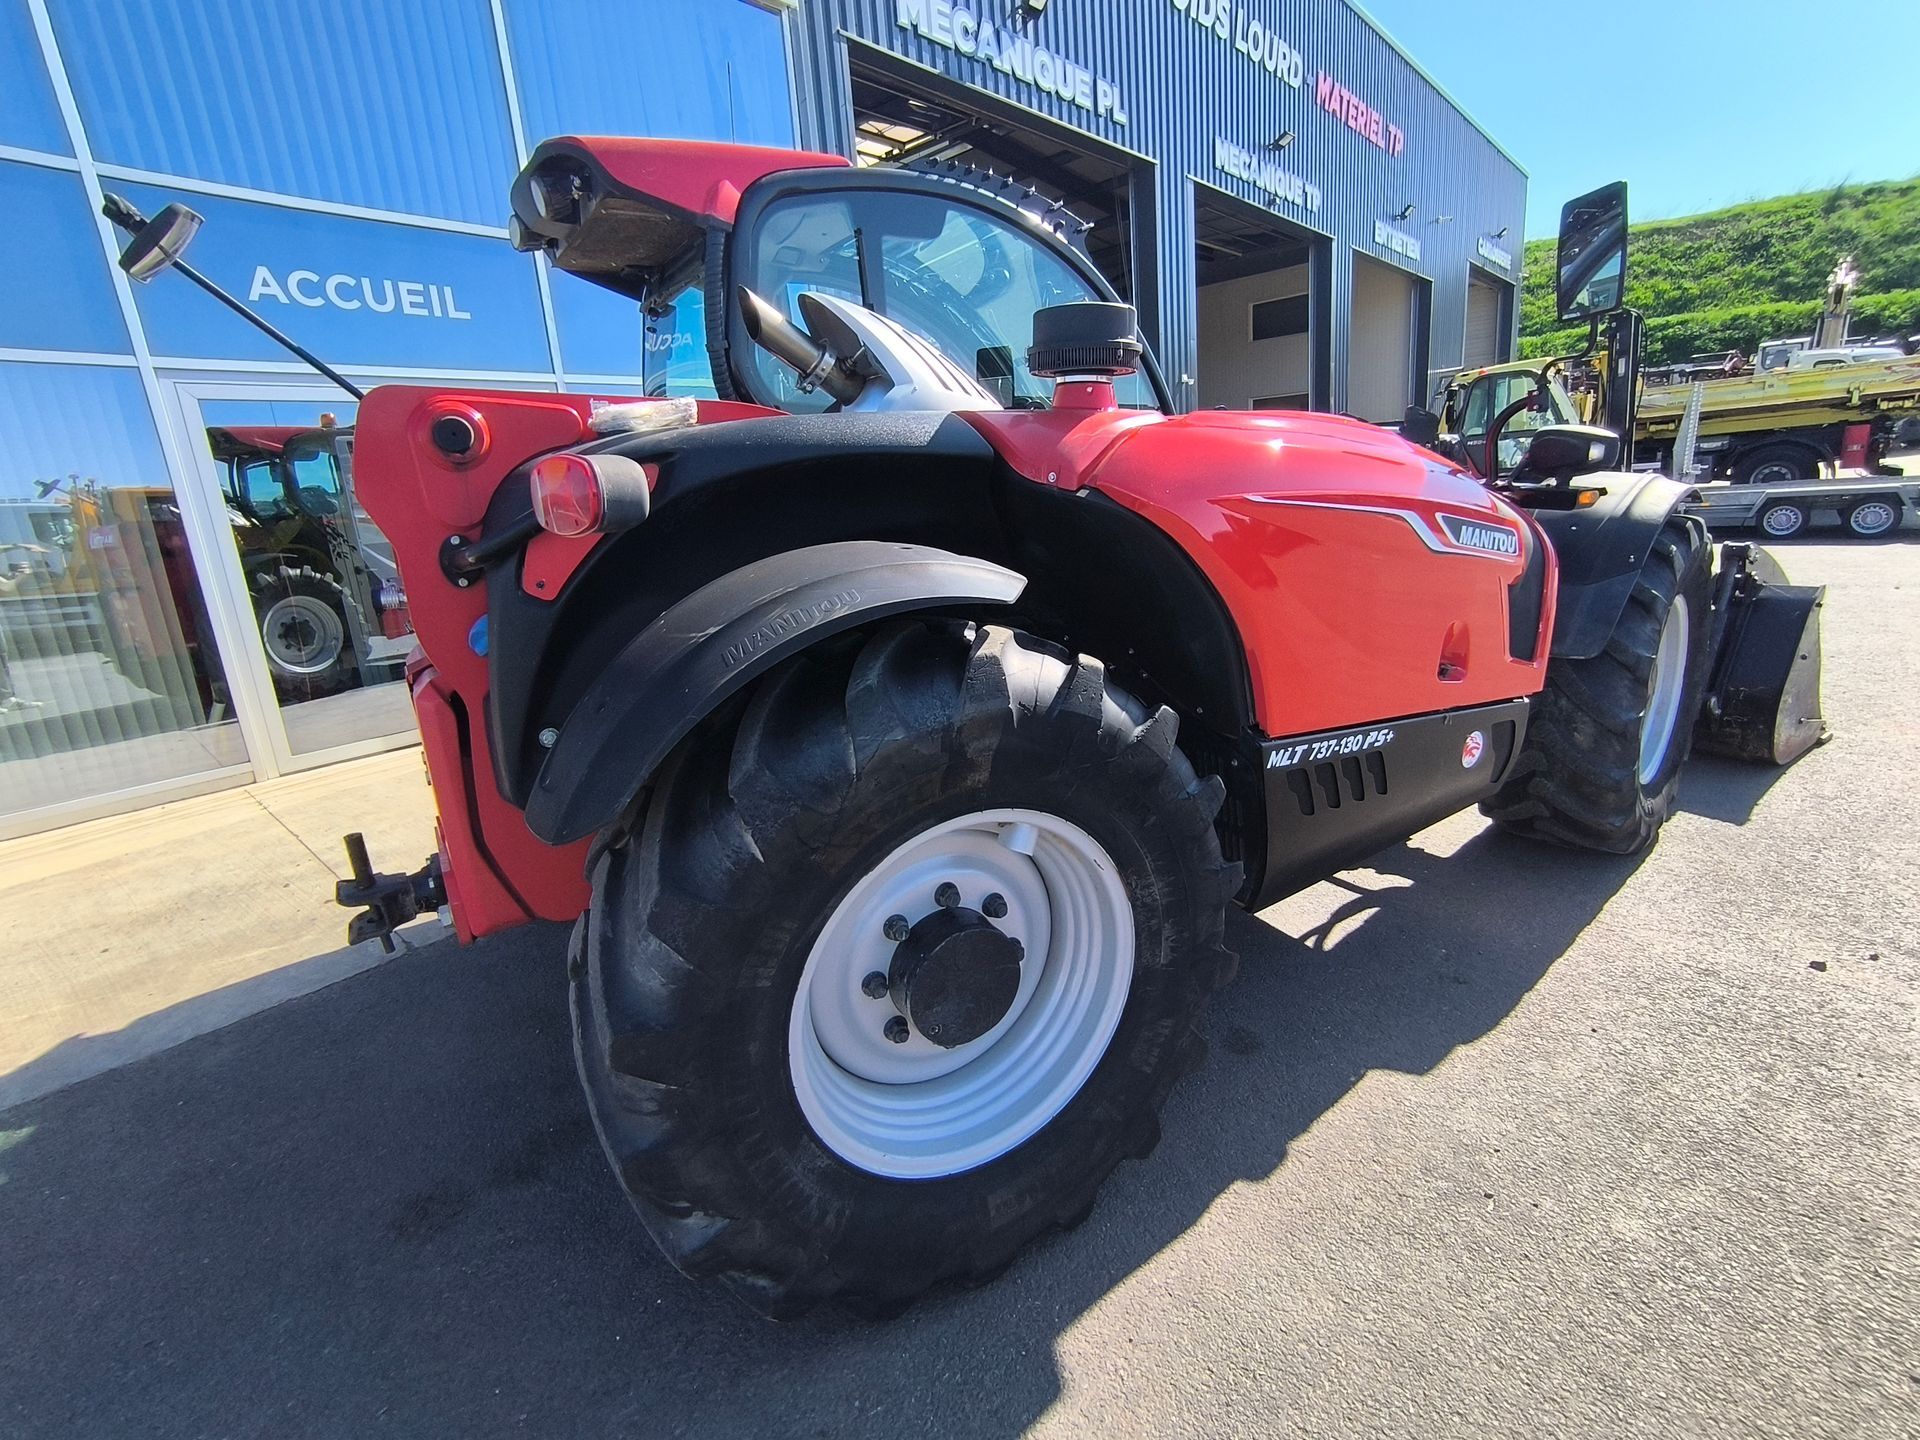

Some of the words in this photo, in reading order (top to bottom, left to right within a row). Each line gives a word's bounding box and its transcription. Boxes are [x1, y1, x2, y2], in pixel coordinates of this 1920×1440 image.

[896, 0, 1093, 111] MECANIQUE
[1096, 74, 1128, 126] PL
[1233, 8, 1304, 89] LOURD
[1316, 70, 1386, 150] MATERIEL
[1387, 122, 1404, 159] TP
[1215, 135, 1304, 206] MECANIQUE
[248, 264, 472, 320] ACCUEIL
[1460, 525, 1516, 553] MANITOU
[720, 588, 862, 668] MANITOU
[1266, 744, 1309, 769] MLT
[1308, 734, 1363, 761] 737-130
[1362, 728, 1395, 750] PS+
